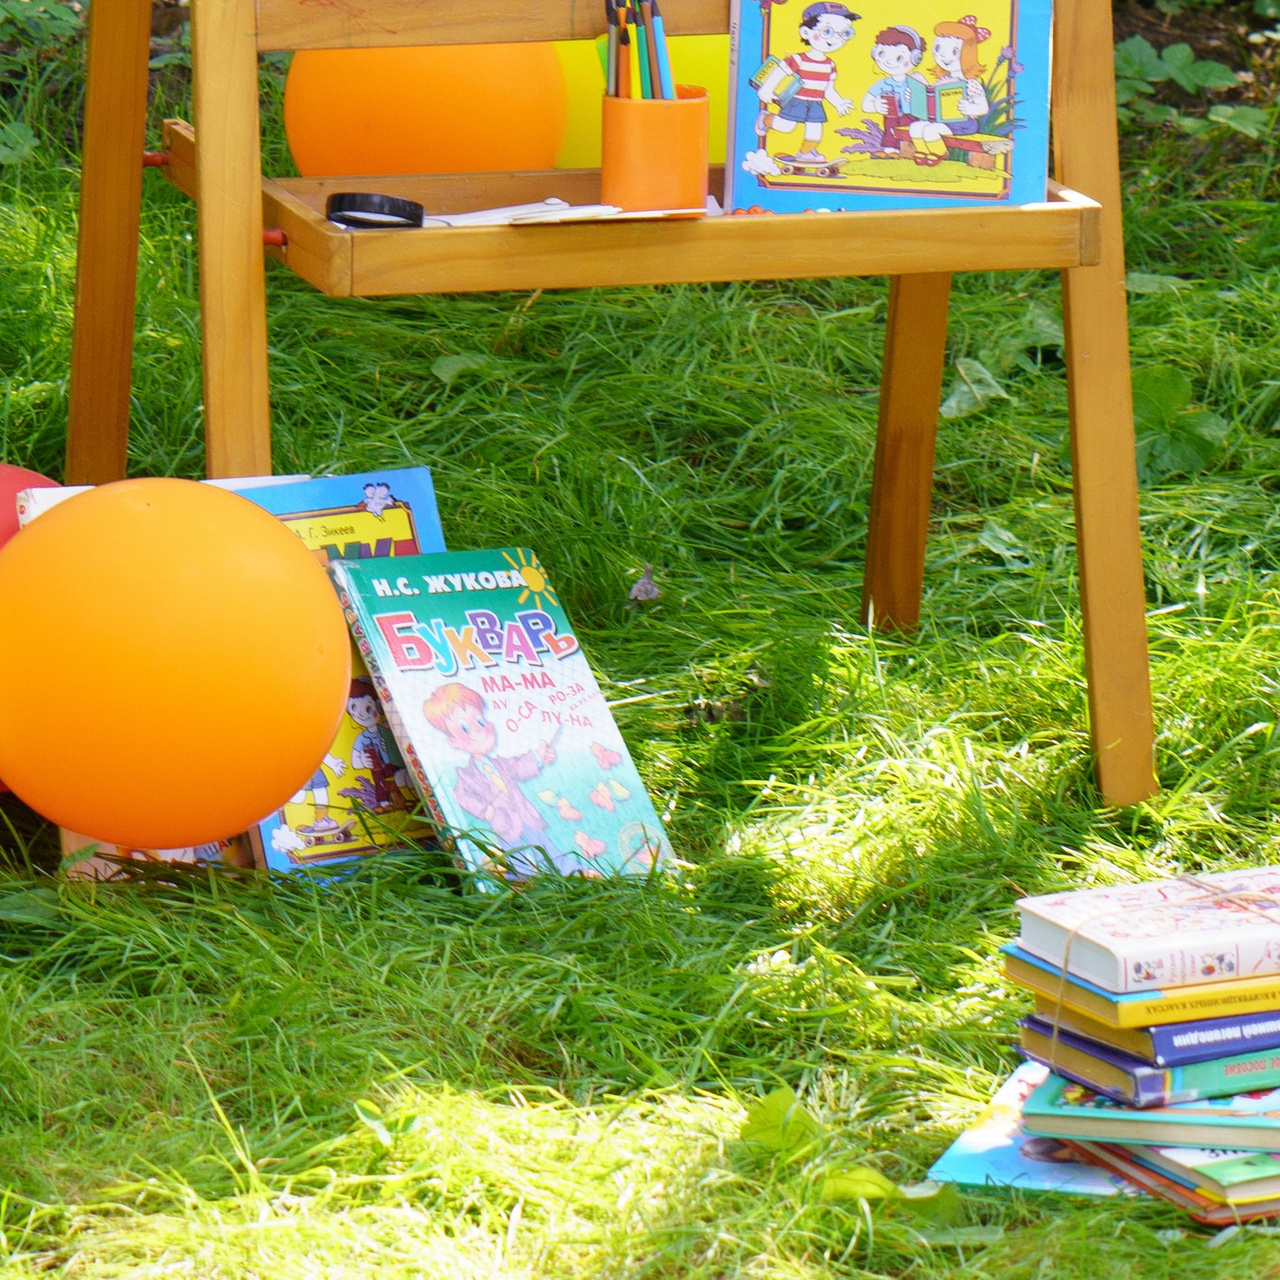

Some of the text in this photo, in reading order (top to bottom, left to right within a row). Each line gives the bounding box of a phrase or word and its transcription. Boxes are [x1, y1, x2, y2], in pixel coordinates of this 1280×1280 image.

[422, 569, 530, 594] ЖУКОВА
[372, 607, 580, 678] БУКВАРЬ
[480, 671, 557, 694] МА-МА
[548, 682, 586, 705] РО-ЗА
[505, 700, 538, 733] О-СА
[540, 710, 593, 729] ЛУ-НА
